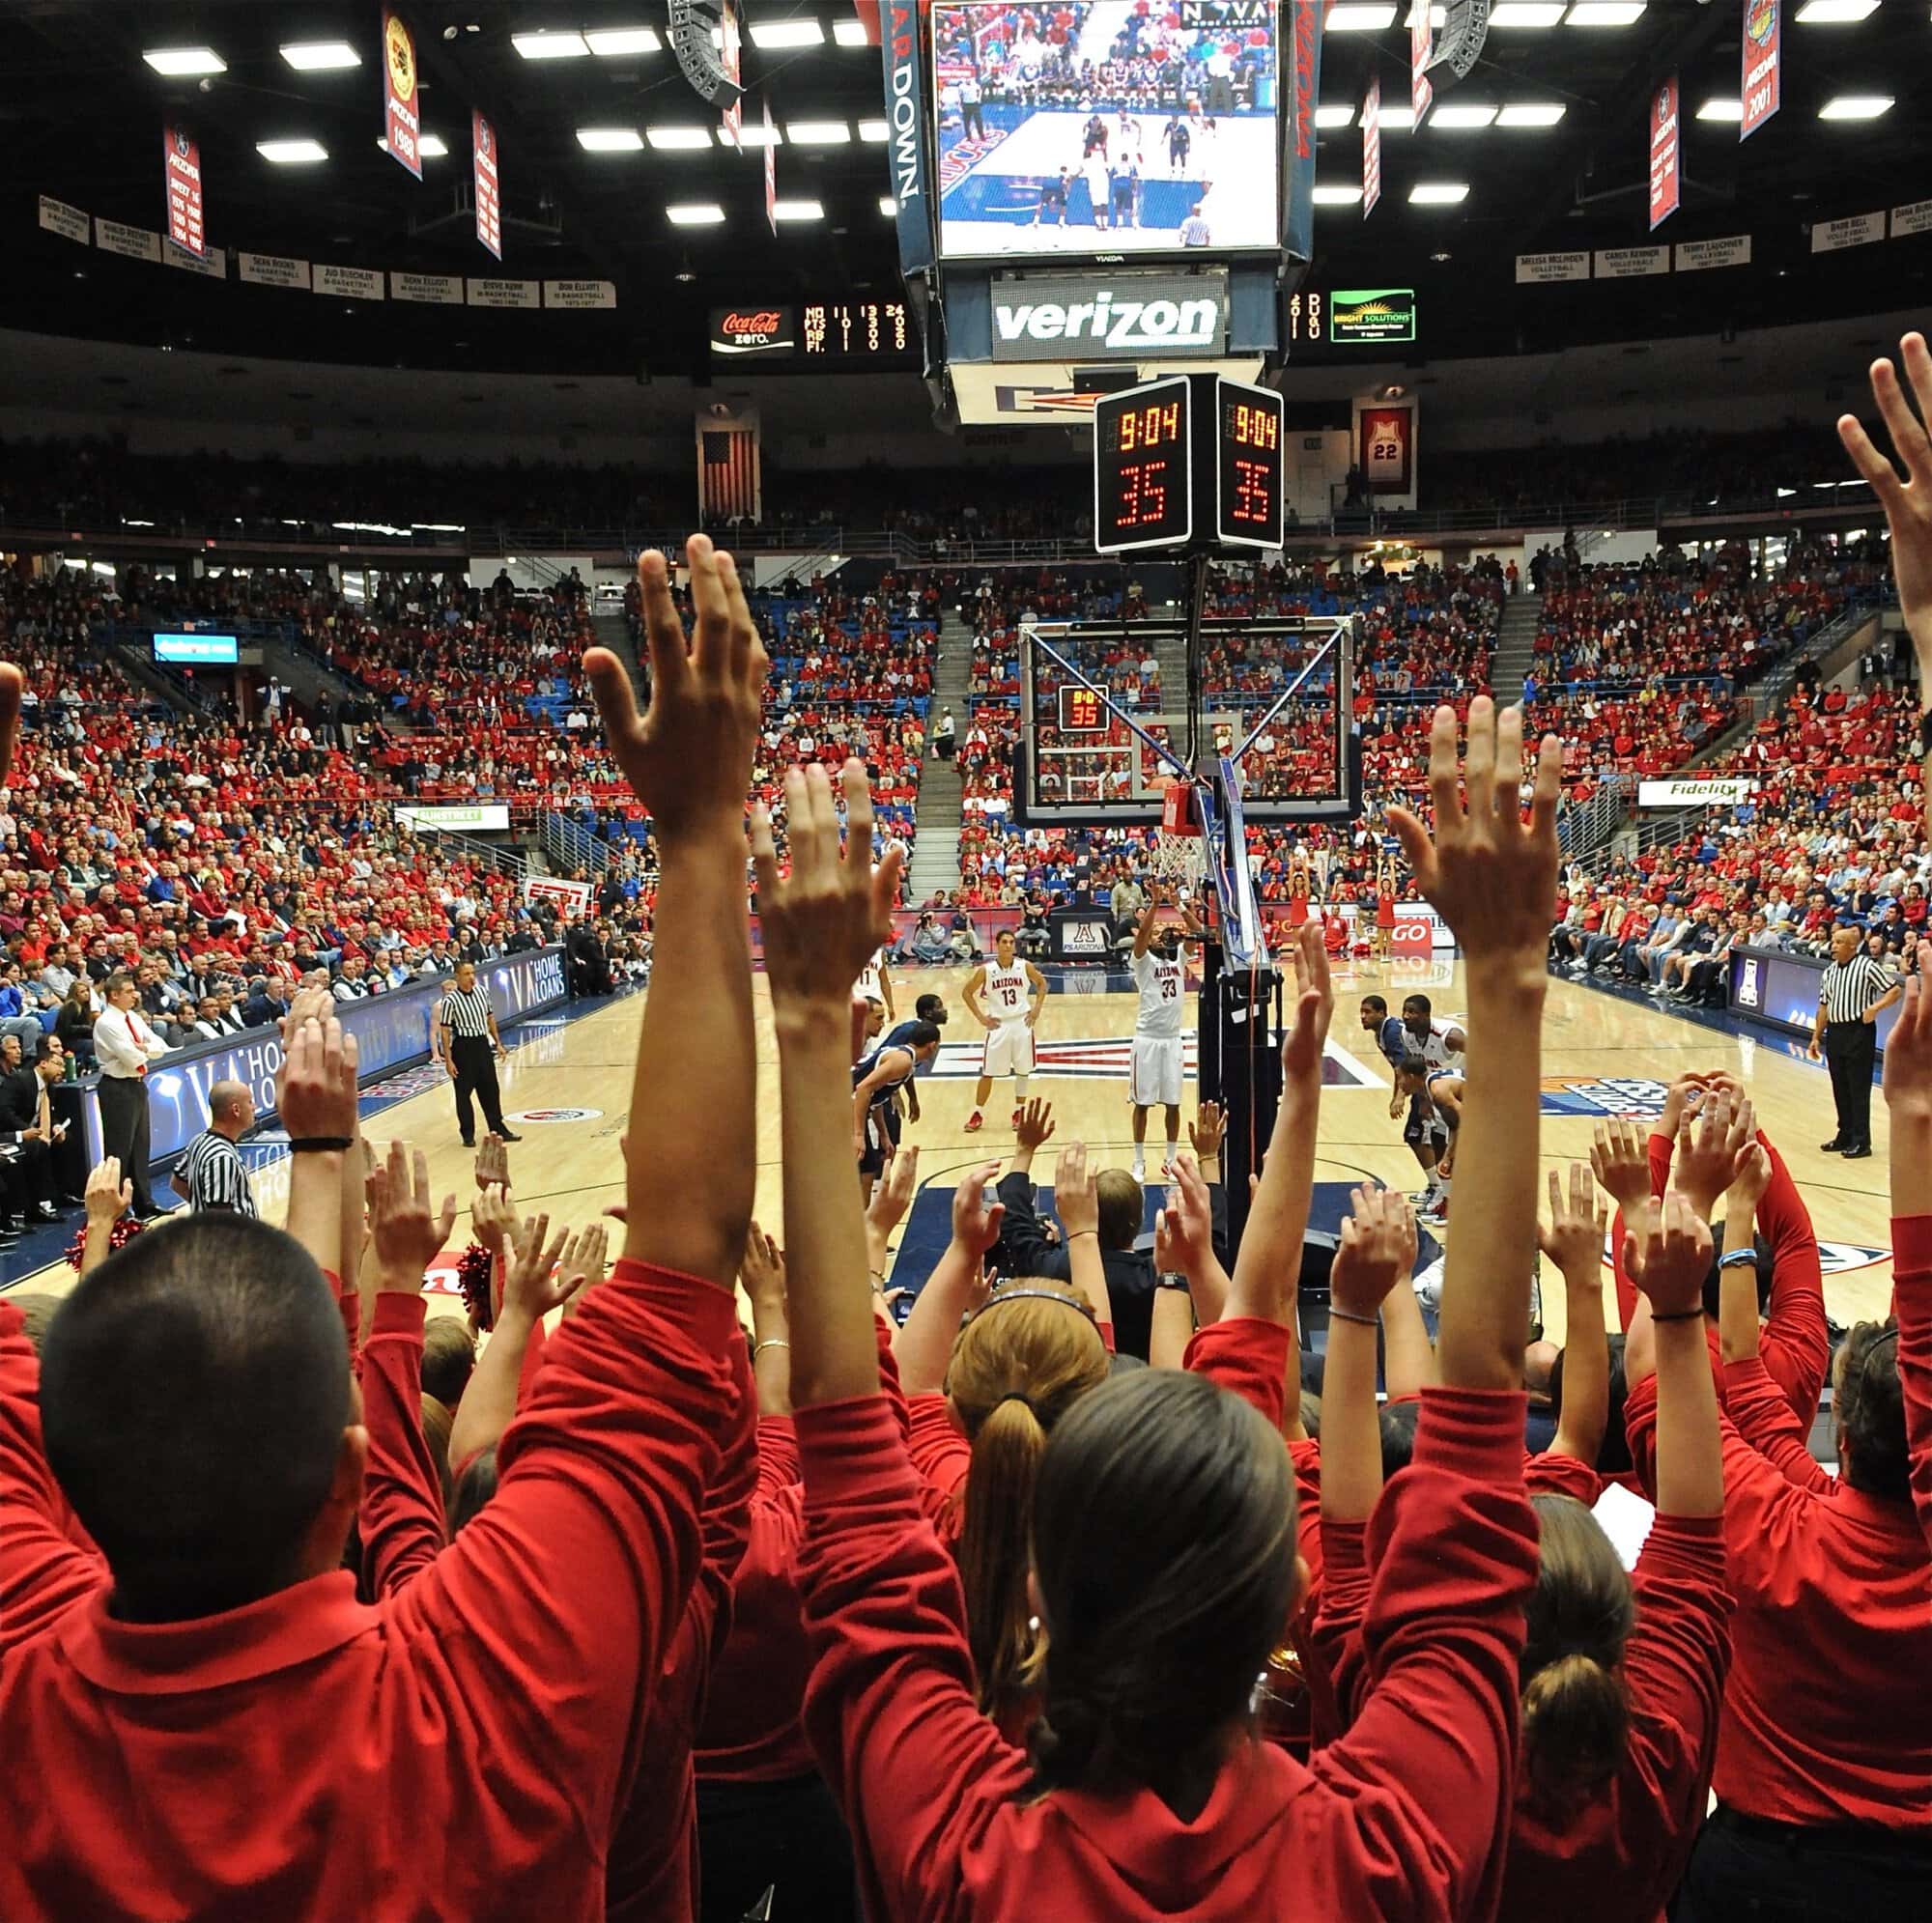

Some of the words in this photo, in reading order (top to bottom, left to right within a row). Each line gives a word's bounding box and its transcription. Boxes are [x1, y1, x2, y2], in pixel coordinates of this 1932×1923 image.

[1746, 50, 1776, 92] ARIZONA
[389, 97, 417, 132] ARIZONA
[1748, 82, 1771, 122] 2001
[394, 127, 414, 160] 1988
[169, 153, 199, 182] ARIZONA
[804, 318, 826, 330] PTS
[806, 307, 824, 319] NO
[835, 306, 848, 319] 11
[861, 305, 877, 318] 13
[886, 304, 904, 317] 24
[996, 292, 1218, 348] verizon
[1365, 314, 1409, 323] SOLUTIONS
[807, 329, 824, 341] RB
[1121, 402, 1179, 451] 9:04
[1236, 406, 1277, 450] 9:04
[1374, 444, 1397, 460] 22
[1117, 461, 1165, 526] 35
[1234, 461, 1269, 523] 35
[1071, 707, 1097, 725] 35
[1670, 783, 1737, 796] Fidelity
[1074, 923, 1095, 943] A
[1392, 924, 1427, 941] GO
[534, 954, 562, 981] HOME
[535, 974, 564, 1003] LOANS
[991, 977, 1024, 990] ARIZONA
[1162, 979, 1177, 998] 33
[1001, 989, 1017, 1006] 13
[249, 1041, 286, 1080] HO
